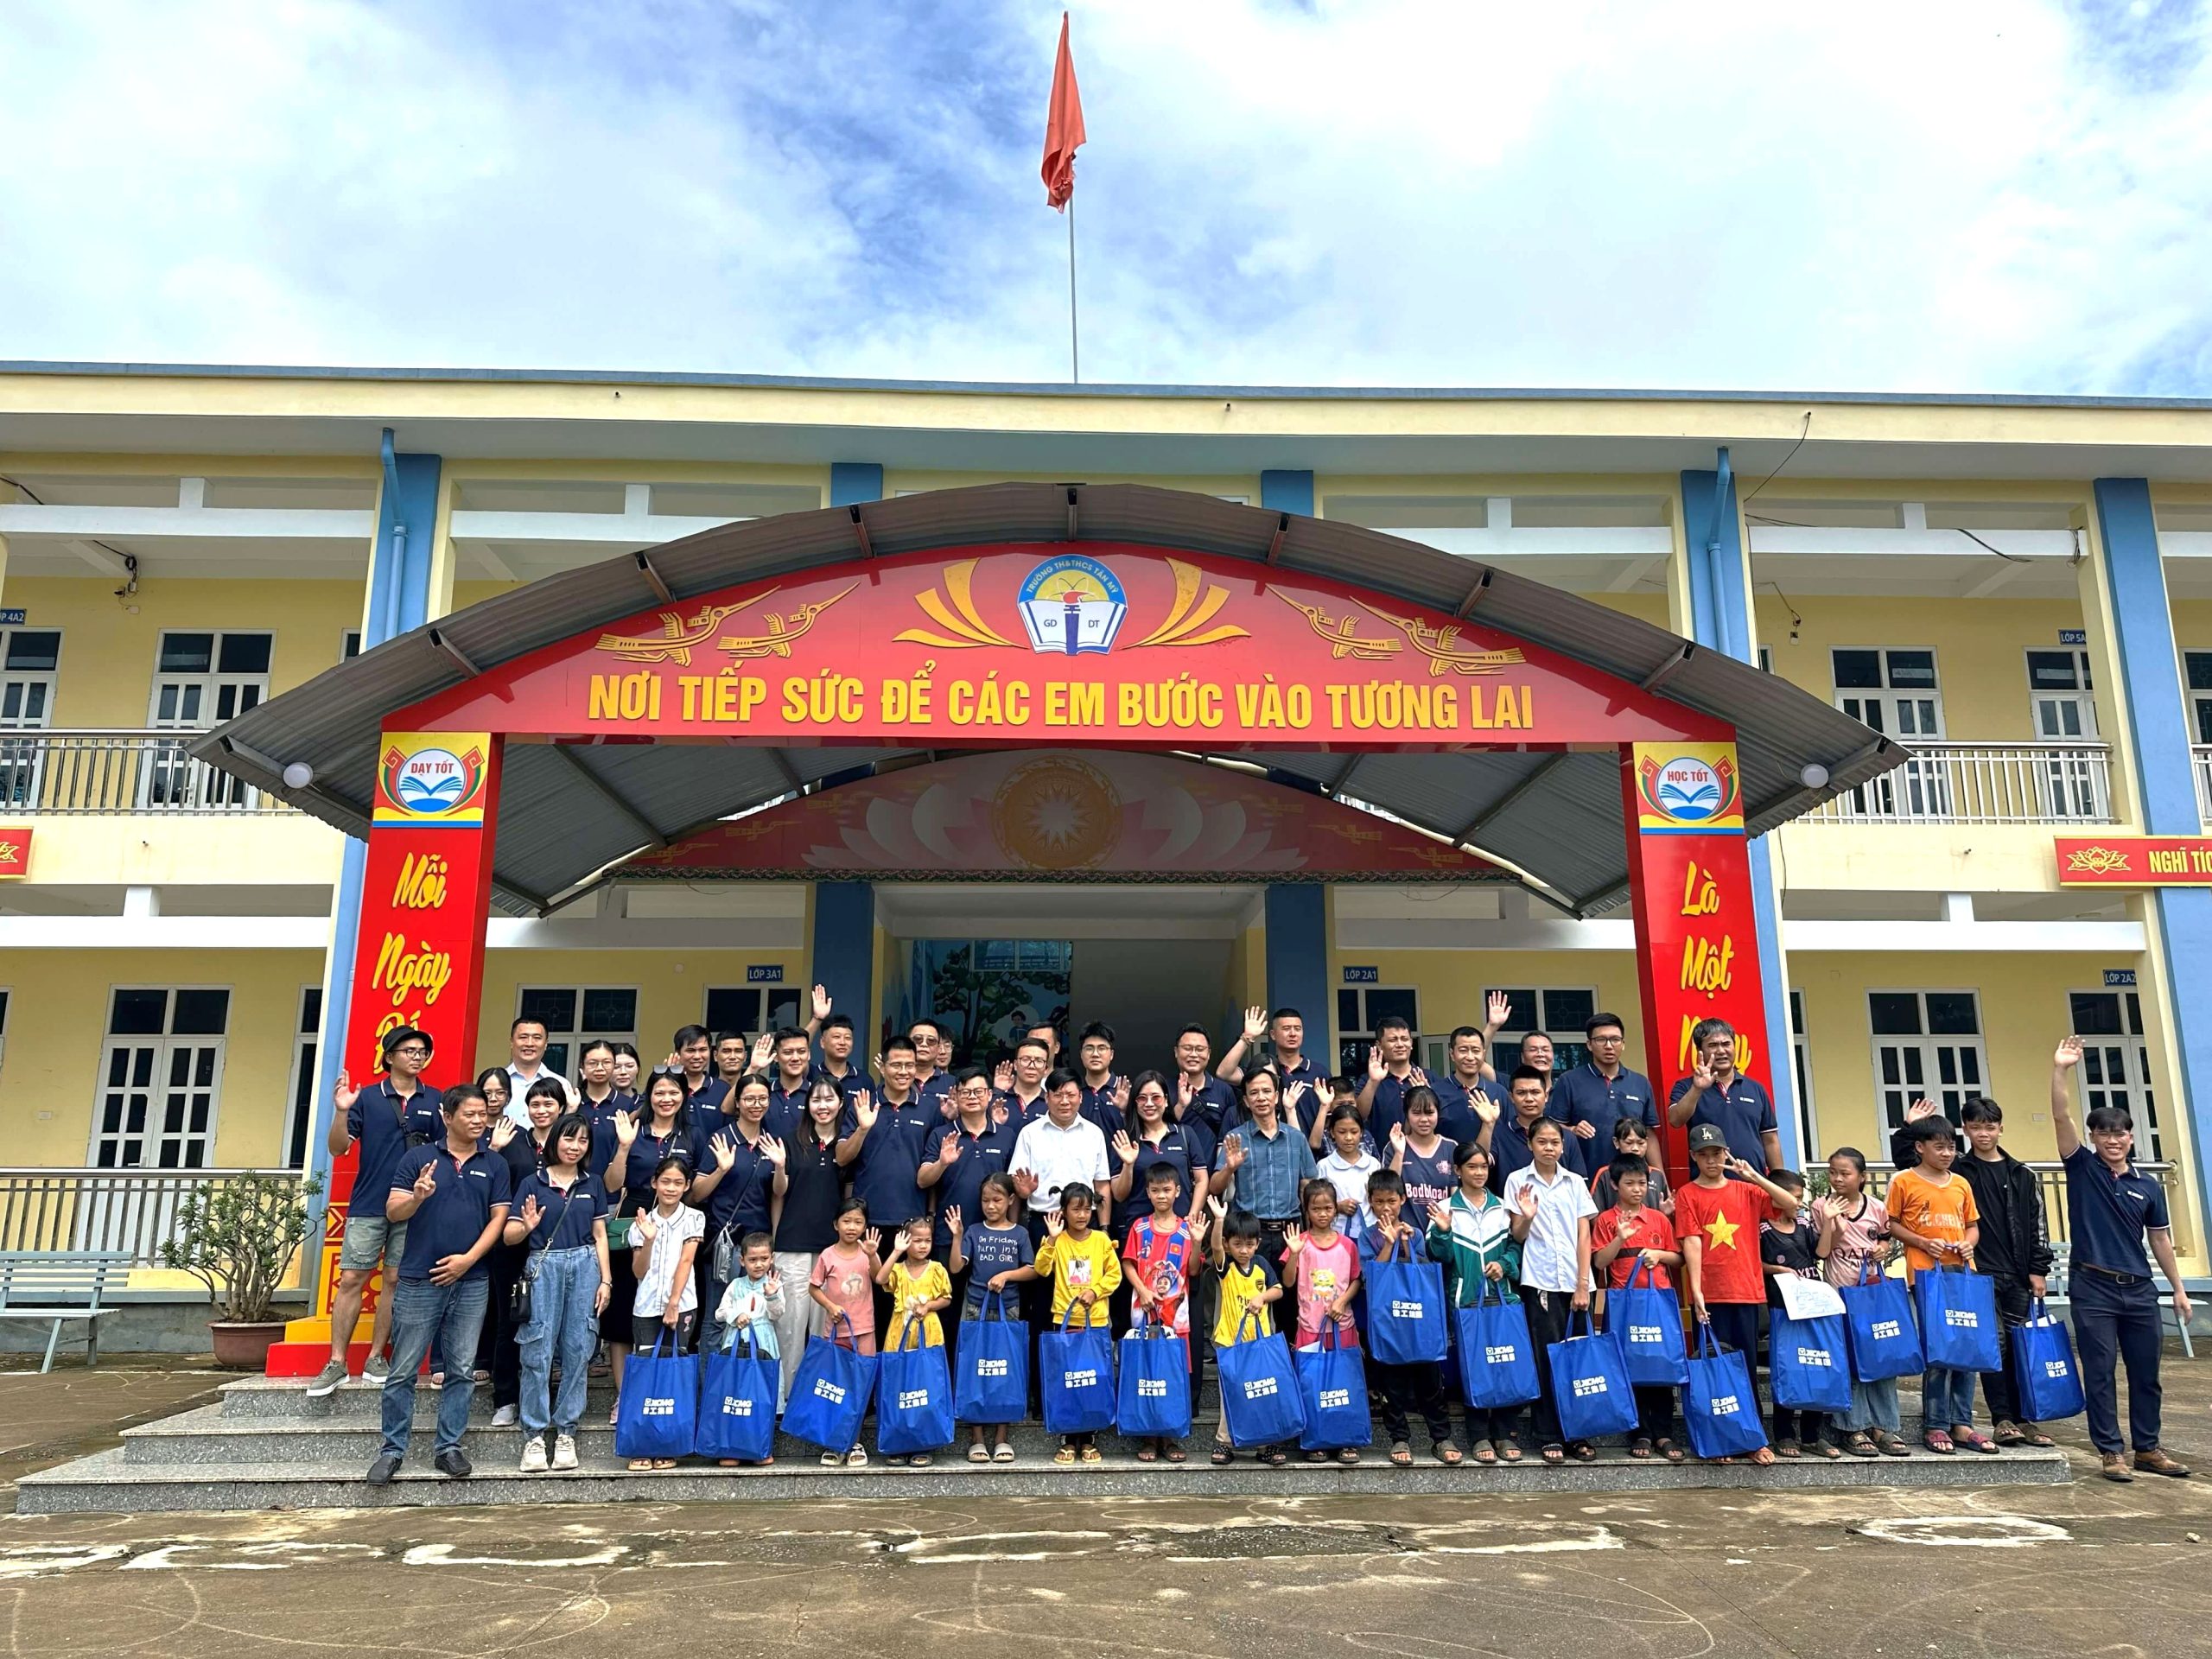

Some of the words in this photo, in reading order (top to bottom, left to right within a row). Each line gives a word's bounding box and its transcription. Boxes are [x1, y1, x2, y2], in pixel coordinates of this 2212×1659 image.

[8, 612, 24, 622] 4A2
[1044, 619, 1057, 627] GD
[588, 671, 662, 720] NƠI
[678, 660, 767, 721] TIẾP
[781, 668, 864, 723] SỨC
[880, 659, 937, 723] ĐỂ
[948, 671, 1030, 725] CÁC
[1045, 681, 1105, 726] EM
[1118, 671, 1224, 728] BƯỚC
[1235, 673, 1313, 728] VÀO
[1325, 679, 1459, 728] TƯƠNG
[1470, 684, 1534, 728] LAI
[410, 762, 432, 777] DẠY
[435, 759, 454, 774] TỐT
[1667, 771, 1688, 784] HỌC
[1690, 767, 1708, 782] TỐT
[2148, 846, 2189, 874] NGHĨ
[392, 852, 448, 908] Mỗi
[1681, 861, 1719, 916] Là
[372, 931, 452, 1007] Ngày
[766, 969, 781, 979] 3A1
[1362, 969, 1376, 980] 2A1
[1681, 934, 1734, 999] Một
[1701, 1127, 1713, 1140] LA
